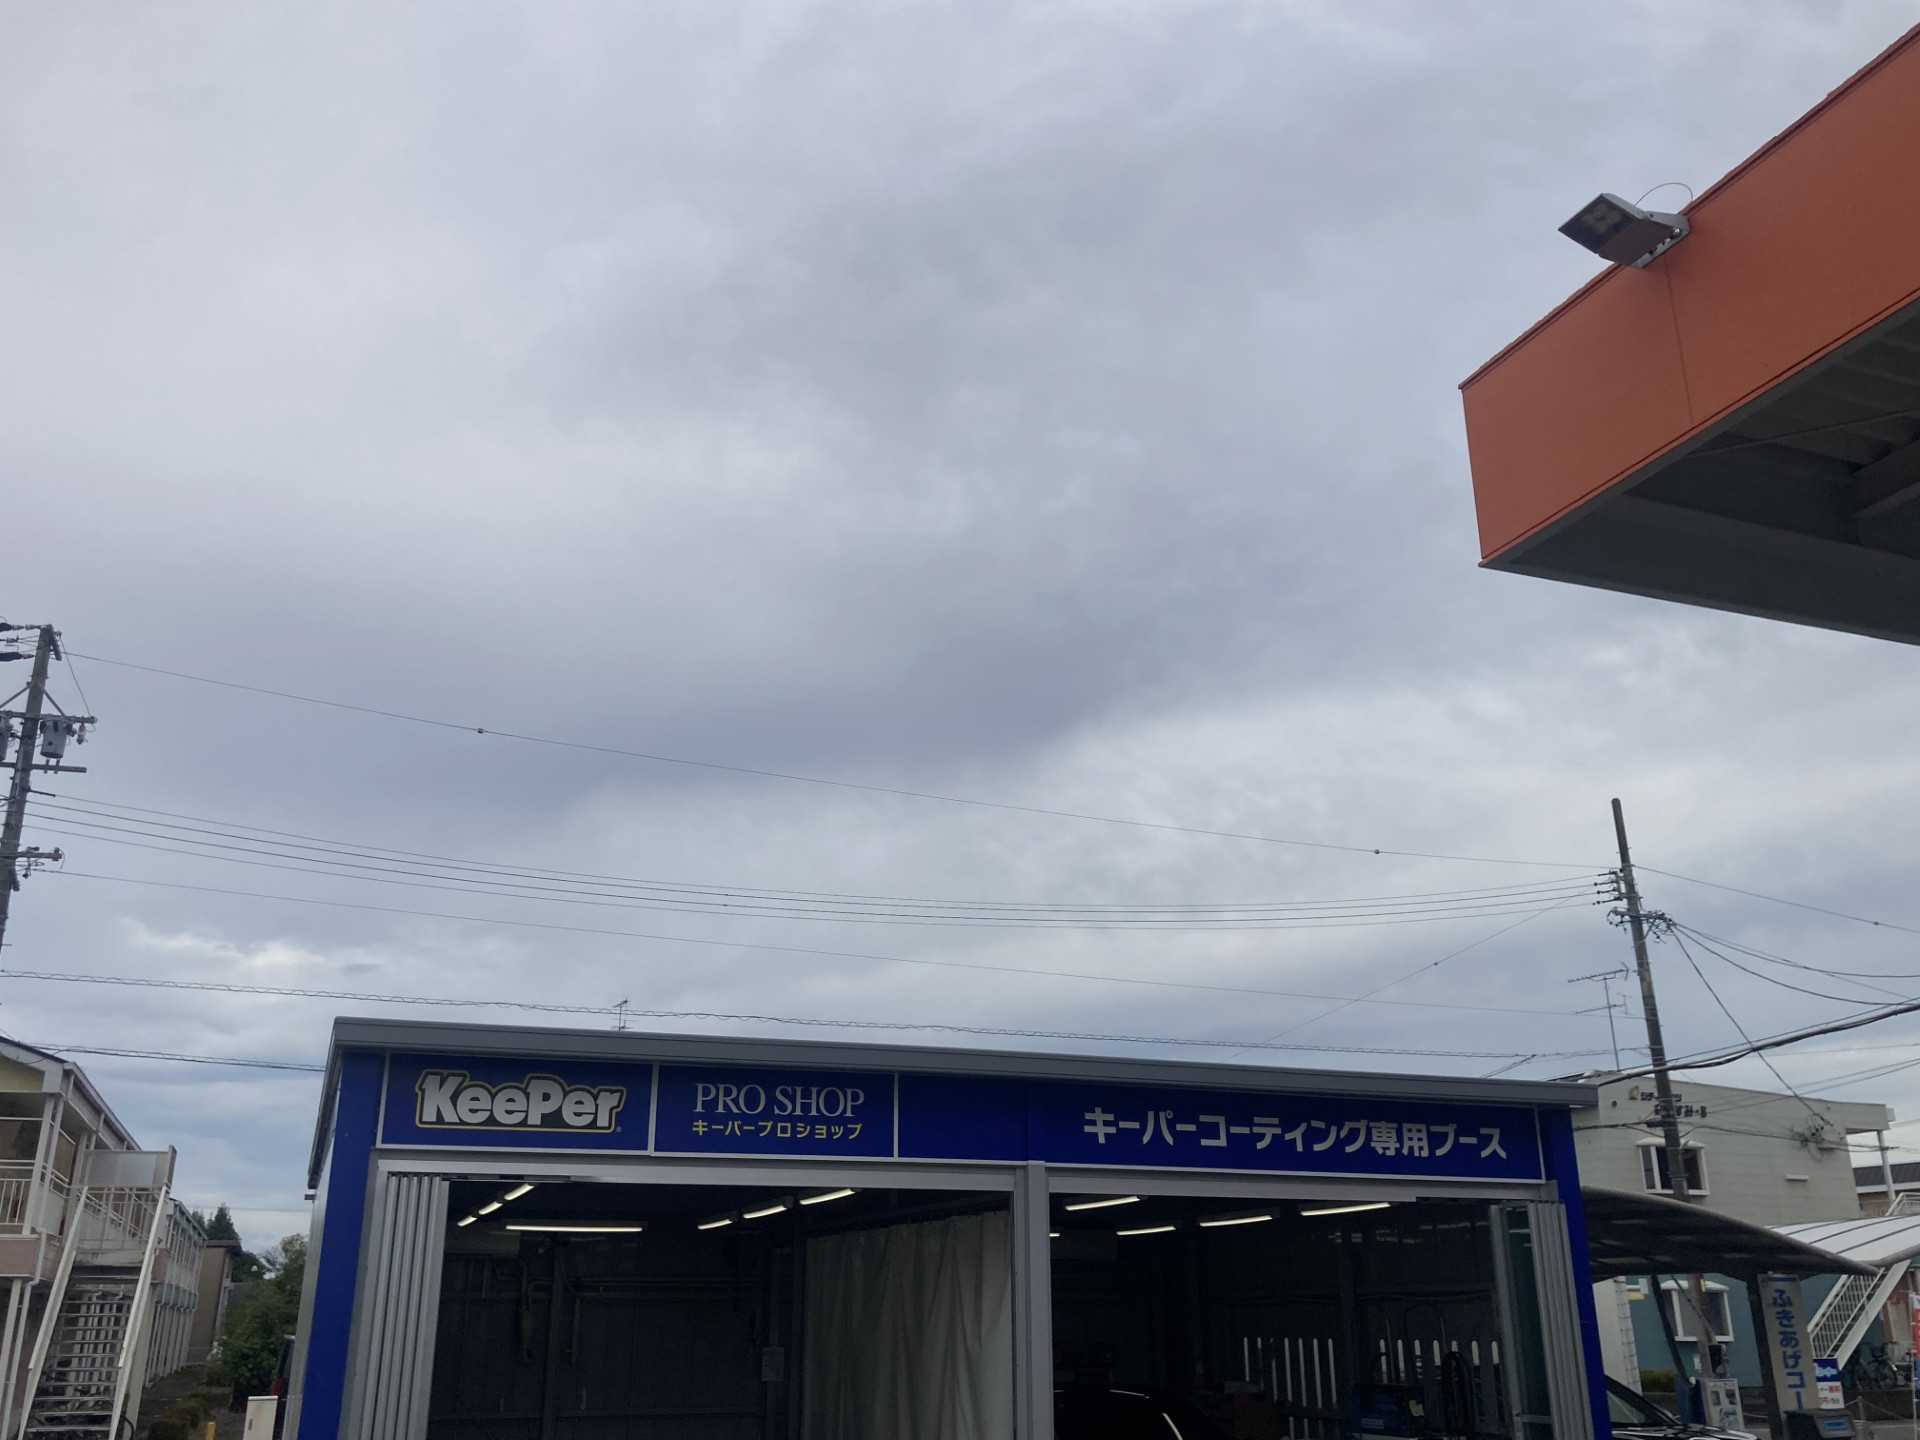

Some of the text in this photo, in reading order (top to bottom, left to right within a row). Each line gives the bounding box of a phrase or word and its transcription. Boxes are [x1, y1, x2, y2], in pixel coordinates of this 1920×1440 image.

[420, 1072, 624, 1128] KeePer
[694, 1082, 865, 1118] PRO SHOP
[692, 1119, 863, 1140] キーパープロショップ
[1083, 1106, 1508, 1160] キーパーコーティング専用ブース
